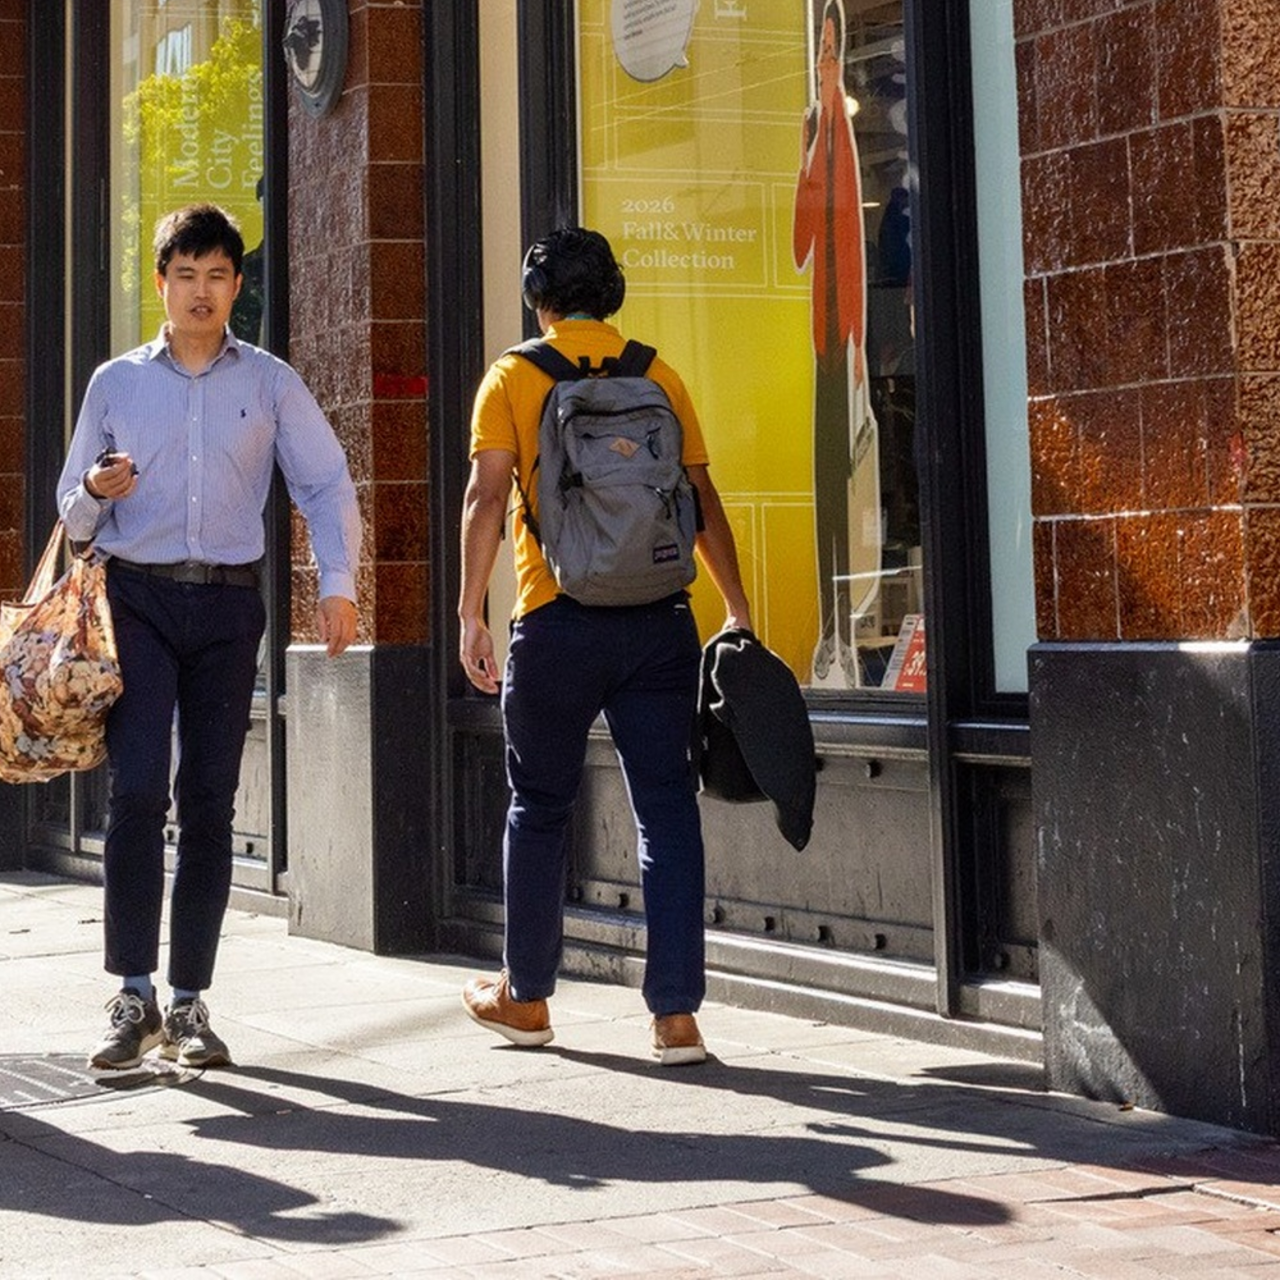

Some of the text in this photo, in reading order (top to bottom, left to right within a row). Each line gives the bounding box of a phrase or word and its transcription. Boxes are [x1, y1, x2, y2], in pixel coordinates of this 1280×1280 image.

[173, 75, 200, 188] Modern
[206, 128, 240, 190] City
[621, 195, 675, 214] 2026
[622, 247, 736, 270] Collection
